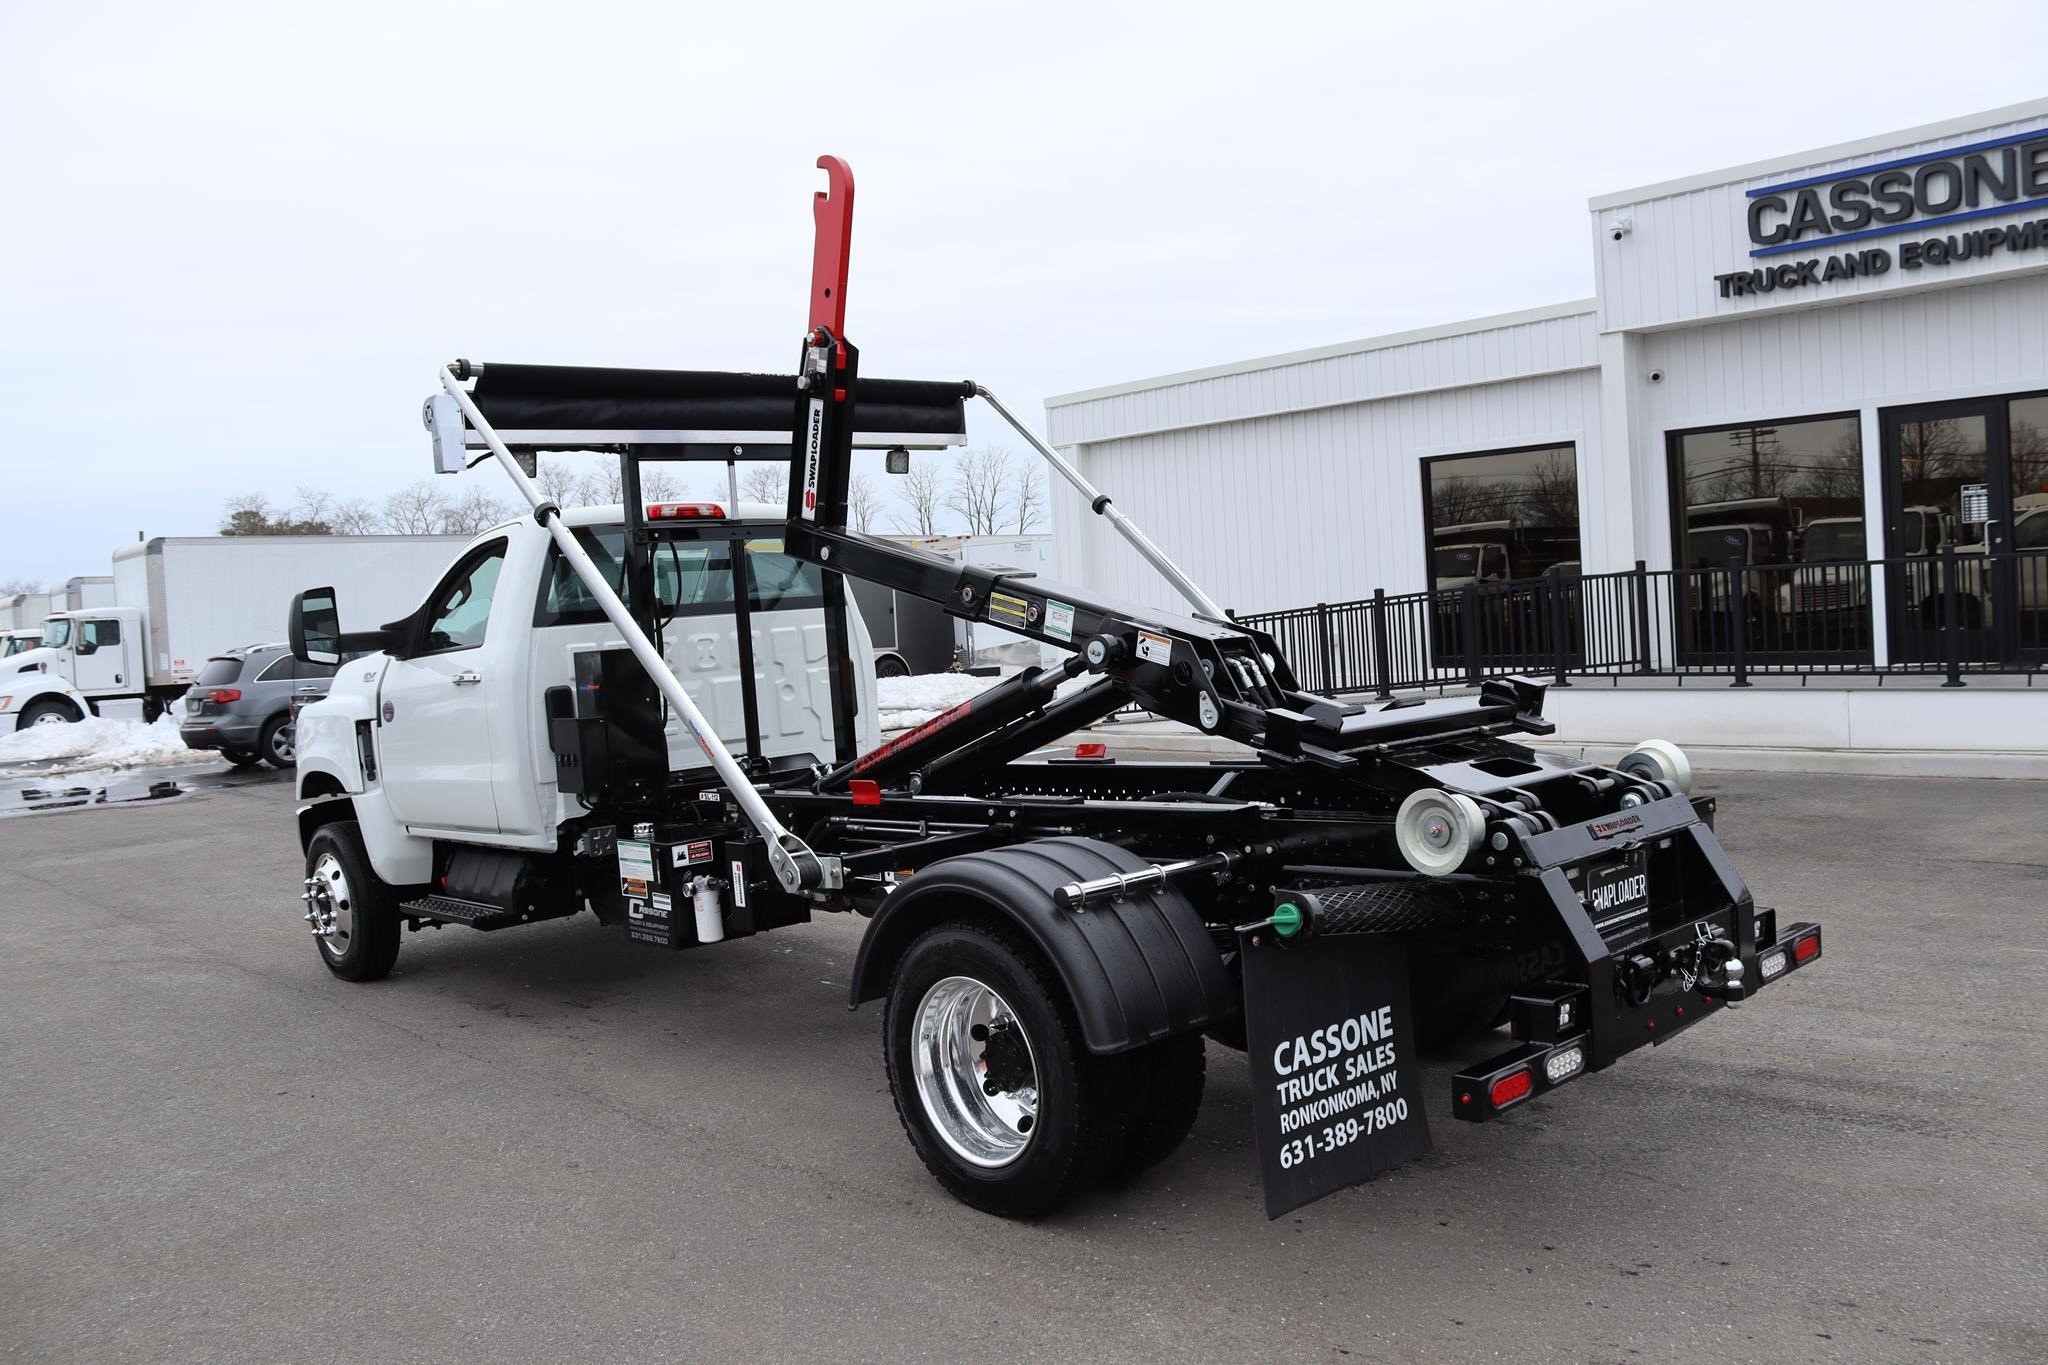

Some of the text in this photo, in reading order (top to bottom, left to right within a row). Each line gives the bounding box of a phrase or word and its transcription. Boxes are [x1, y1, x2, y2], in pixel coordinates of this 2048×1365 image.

[1748, 140, 2048, 245] CASSONE
[1714, 258, 1821, 298] TRUCK
[1821, 247, 1891, 282] AND
[808, 409, 821, 488] SWAPLOADER
[629, 898, 668, 919] CASSONE
[1273, 1005, 1394, 1076] CASSONE
[1276, 1042, 1396, 1106] TRUCK SALES
[1280, 1070, 1398, 1135] RONKONKOMA, NY
[1280, 1097, 1408, 1169] 631-389-7800
